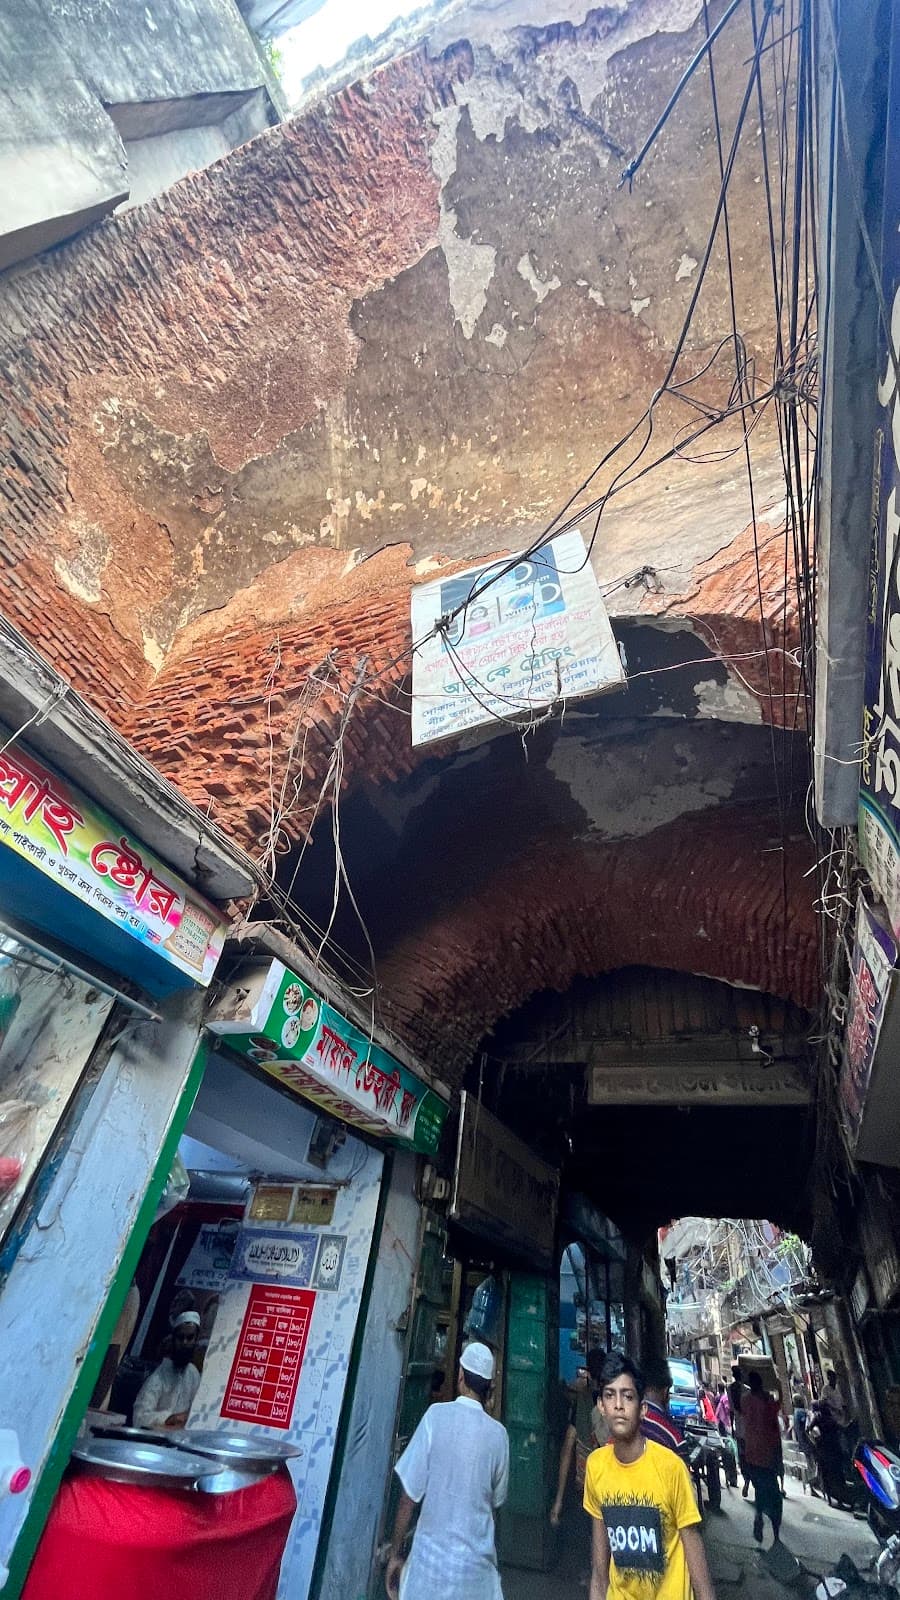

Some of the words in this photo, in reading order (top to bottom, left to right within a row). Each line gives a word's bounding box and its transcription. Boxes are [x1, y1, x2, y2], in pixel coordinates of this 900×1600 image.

[487, 664, 511, 682] কে
[13, 830, 46, 861] পাইকারী
[48, 857, 56, 867] ও
[58, 862, 79, 884] খুচরা
[115, 904, 129, 921] করা
[90, 836, 181, 924] ষ্টোর
[607, 1525, 657, 1553] BOOM
